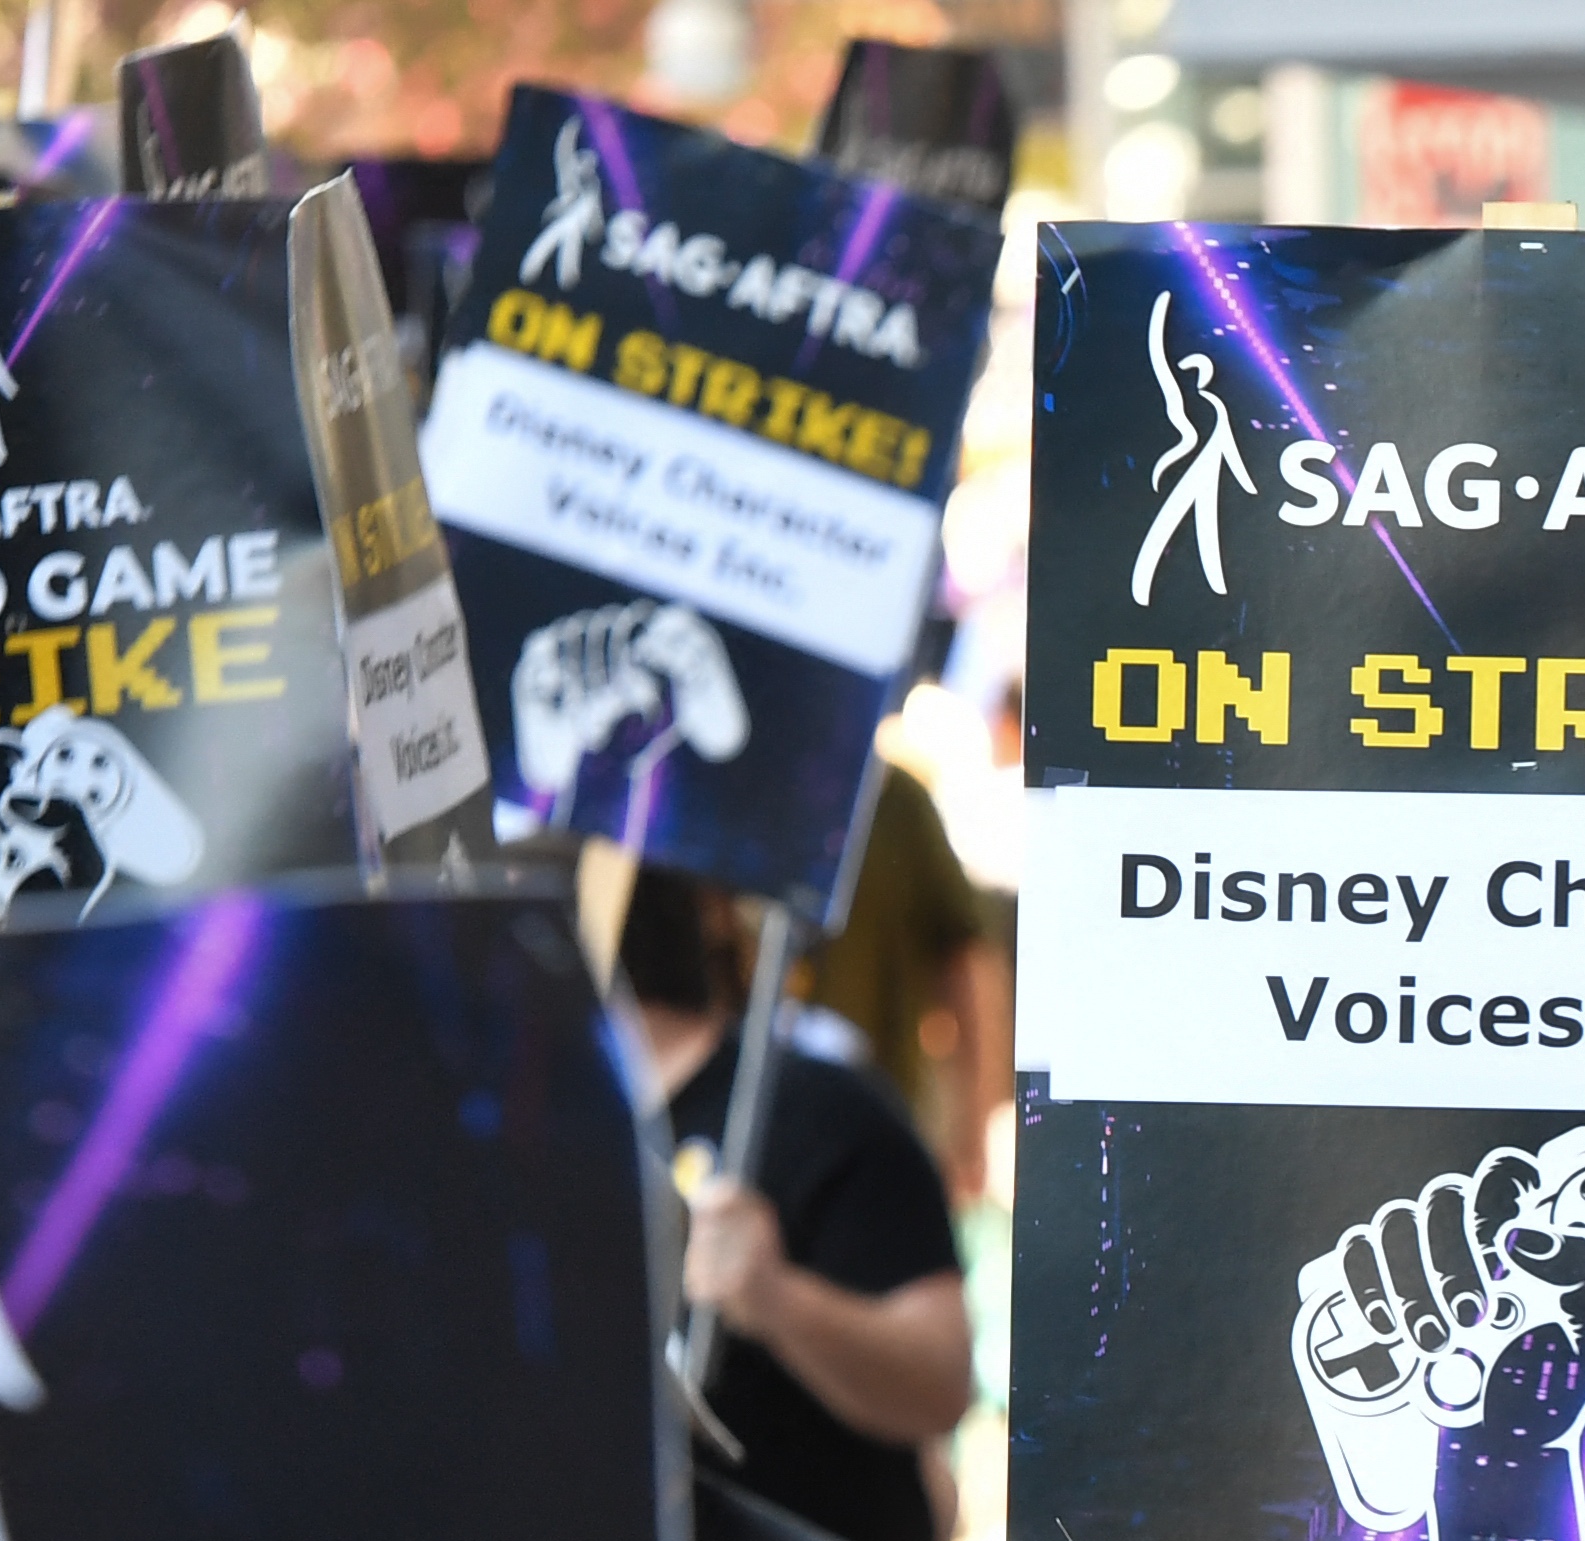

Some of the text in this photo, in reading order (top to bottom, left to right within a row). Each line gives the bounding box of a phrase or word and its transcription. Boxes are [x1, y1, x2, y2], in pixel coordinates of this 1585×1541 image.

[486, 288, 606, 376] ON
[615, 330, 933, 490] STRIKE!
[27, 529, 285, 622] GAME
[1092, 647, 1292, 745] ON
[1118, 850, 1450, 942] Disney
[1266, 975, 1585, 1046] Voices
